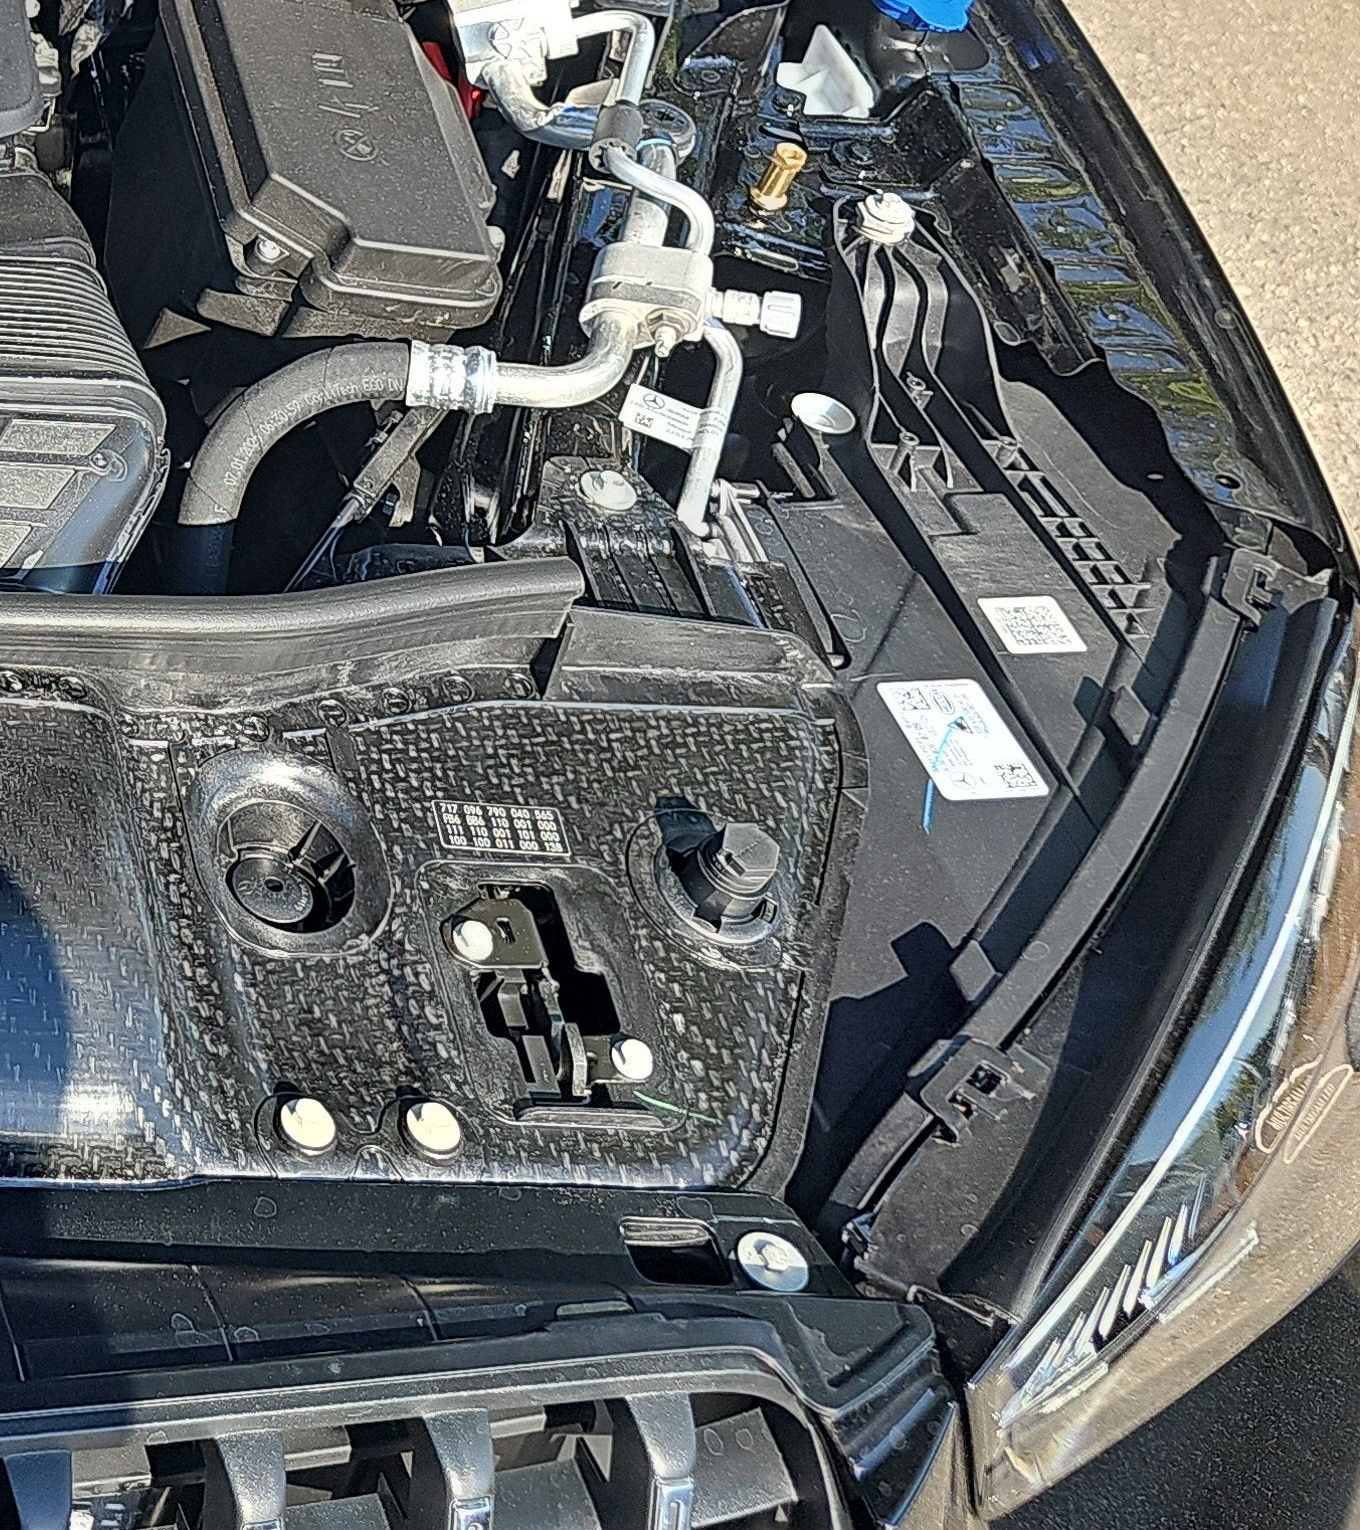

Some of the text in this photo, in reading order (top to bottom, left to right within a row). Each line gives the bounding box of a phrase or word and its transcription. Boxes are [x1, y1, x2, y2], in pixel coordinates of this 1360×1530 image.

[440, 802, 458, 812] 717
[463, 804, 482, 814] 096
[487, 806, 506, 816] 790
[511, 808, 530, 818] 040
[490, 817, 509, 827] 110
[513, 819, 533, 829] 001
[537, 821, 557, 831] 000
[445, 824, 560, 842] 111 110 001 101 000
[447, 835, 466, 844] 100
[471, 837, 490, 846] 100
[495, 839, 515, 848] 011
[519, 841, 539, 850] 000
